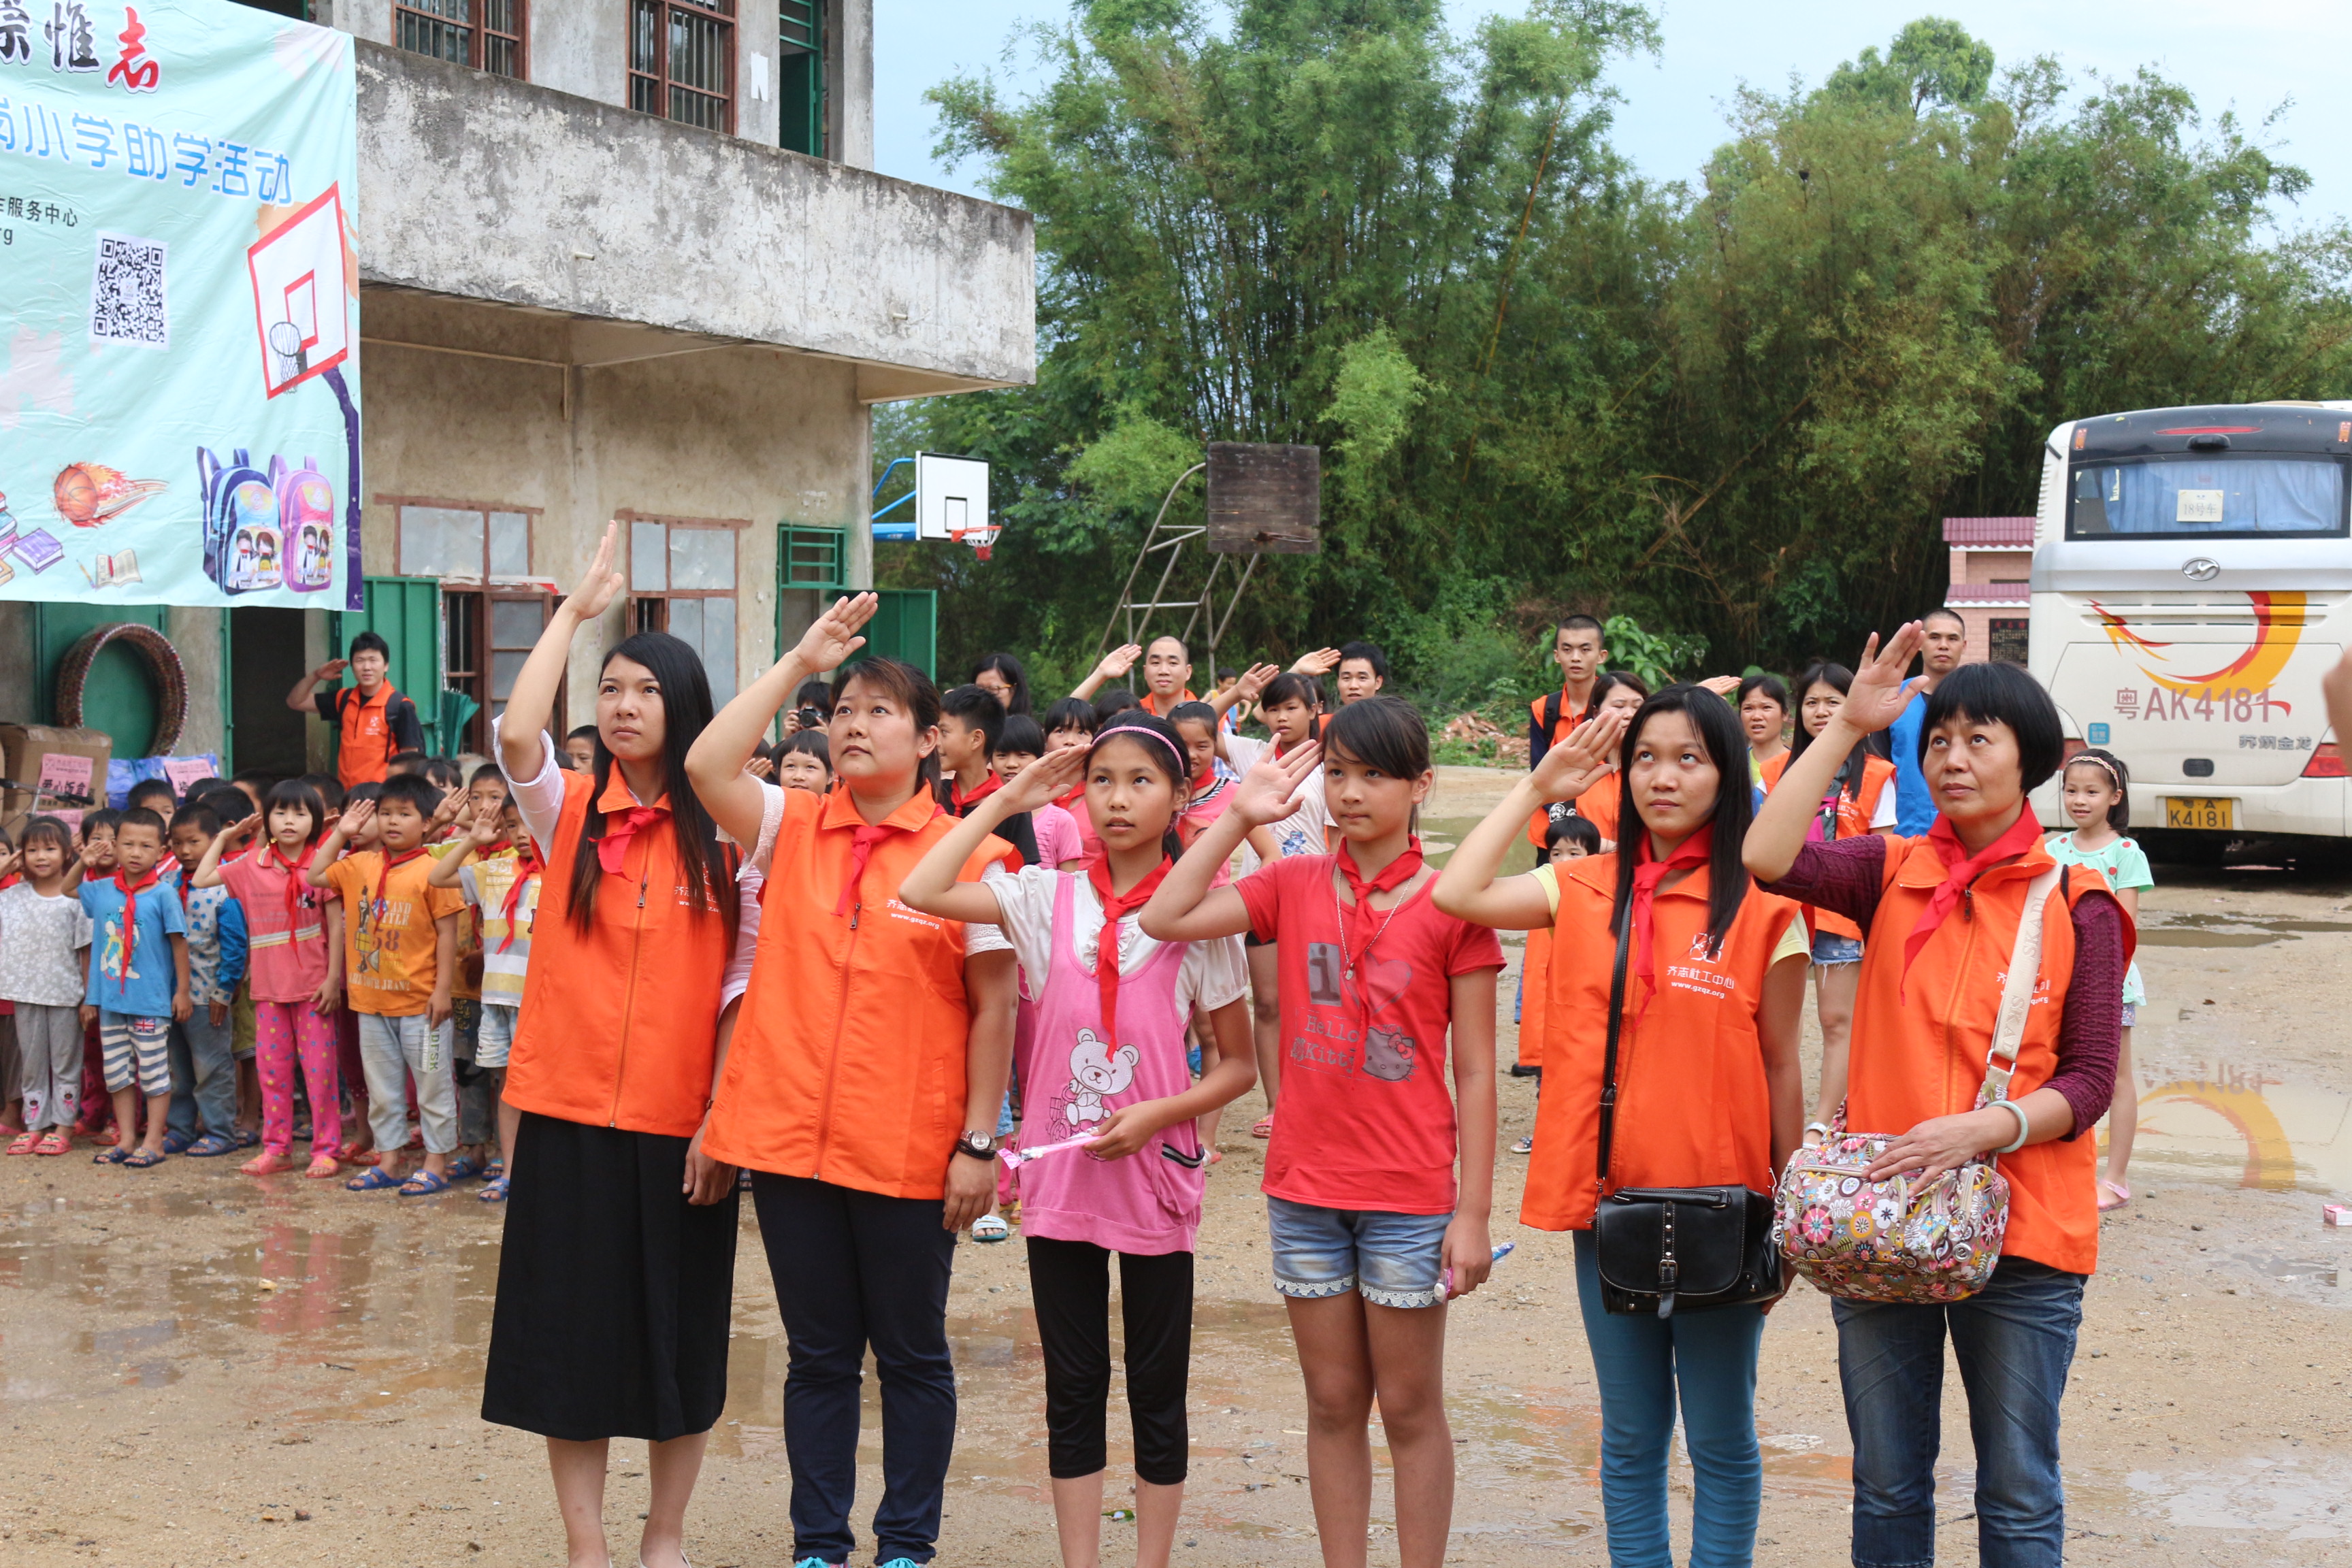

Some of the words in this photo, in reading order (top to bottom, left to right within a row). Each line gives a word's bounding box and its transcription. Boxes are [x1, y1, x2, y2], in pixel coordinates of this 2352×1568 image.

[0, 197, 78, 227] 服务中心
[2114, 687, 2270, 723] 粤AK4181
[2170, 810, 2225, 828] K4181
[891, 913, 940, 930] www.gzqz.org
[1667, 966, 1735, 990] 齐志社工中心
[1671, 981, 1725, 999] www.gzqz.org
[1305, 1015, 1360, 1043] Hello
